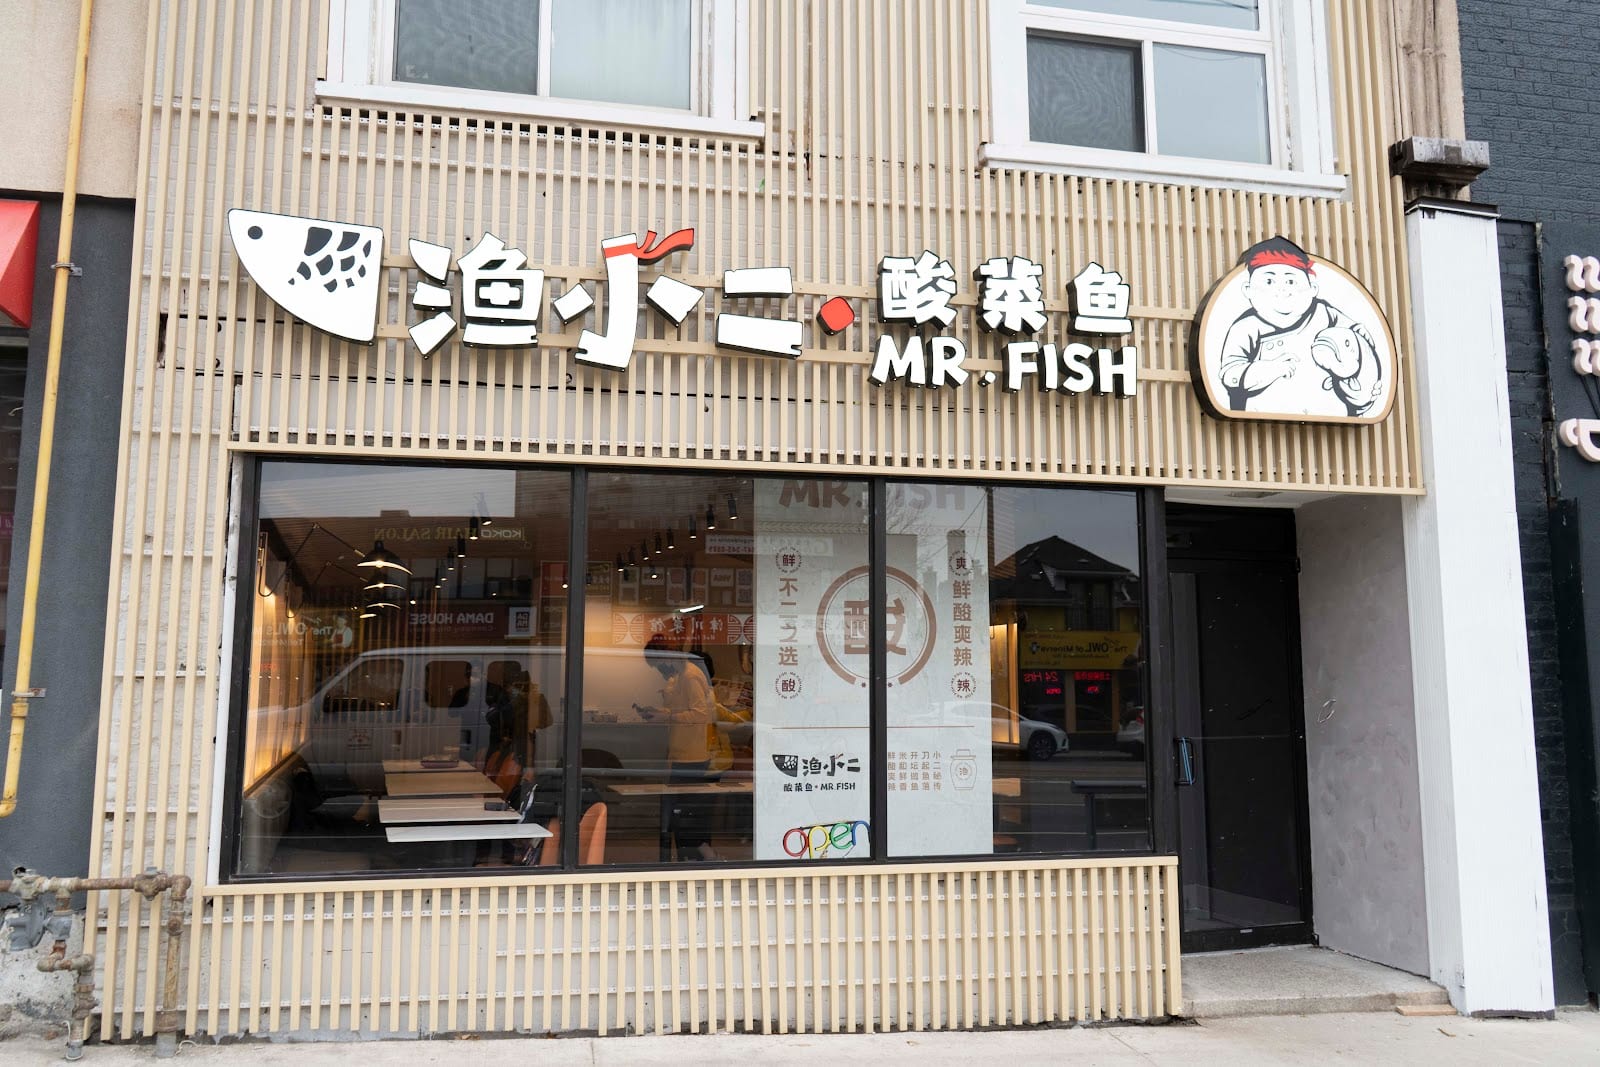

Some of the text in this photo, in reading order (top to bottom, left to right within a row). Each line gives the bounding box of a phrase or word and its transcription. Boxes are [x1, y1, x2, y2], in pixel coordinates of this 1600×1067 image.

[408, 228, 803, 372] 渔小二
[878, 249, 1134, 337] 酸菜鱼
[778, 577, 799, 667] 不二之选
[952, 580, 973, 667] 鲜酸爽辣
[781, 679, 795, 693] 酸
[956, 679, 970, 692] 辣
[783, 782, 813, 792] 酸菜鱼
[802, 753, 861, 777] 渔小二
